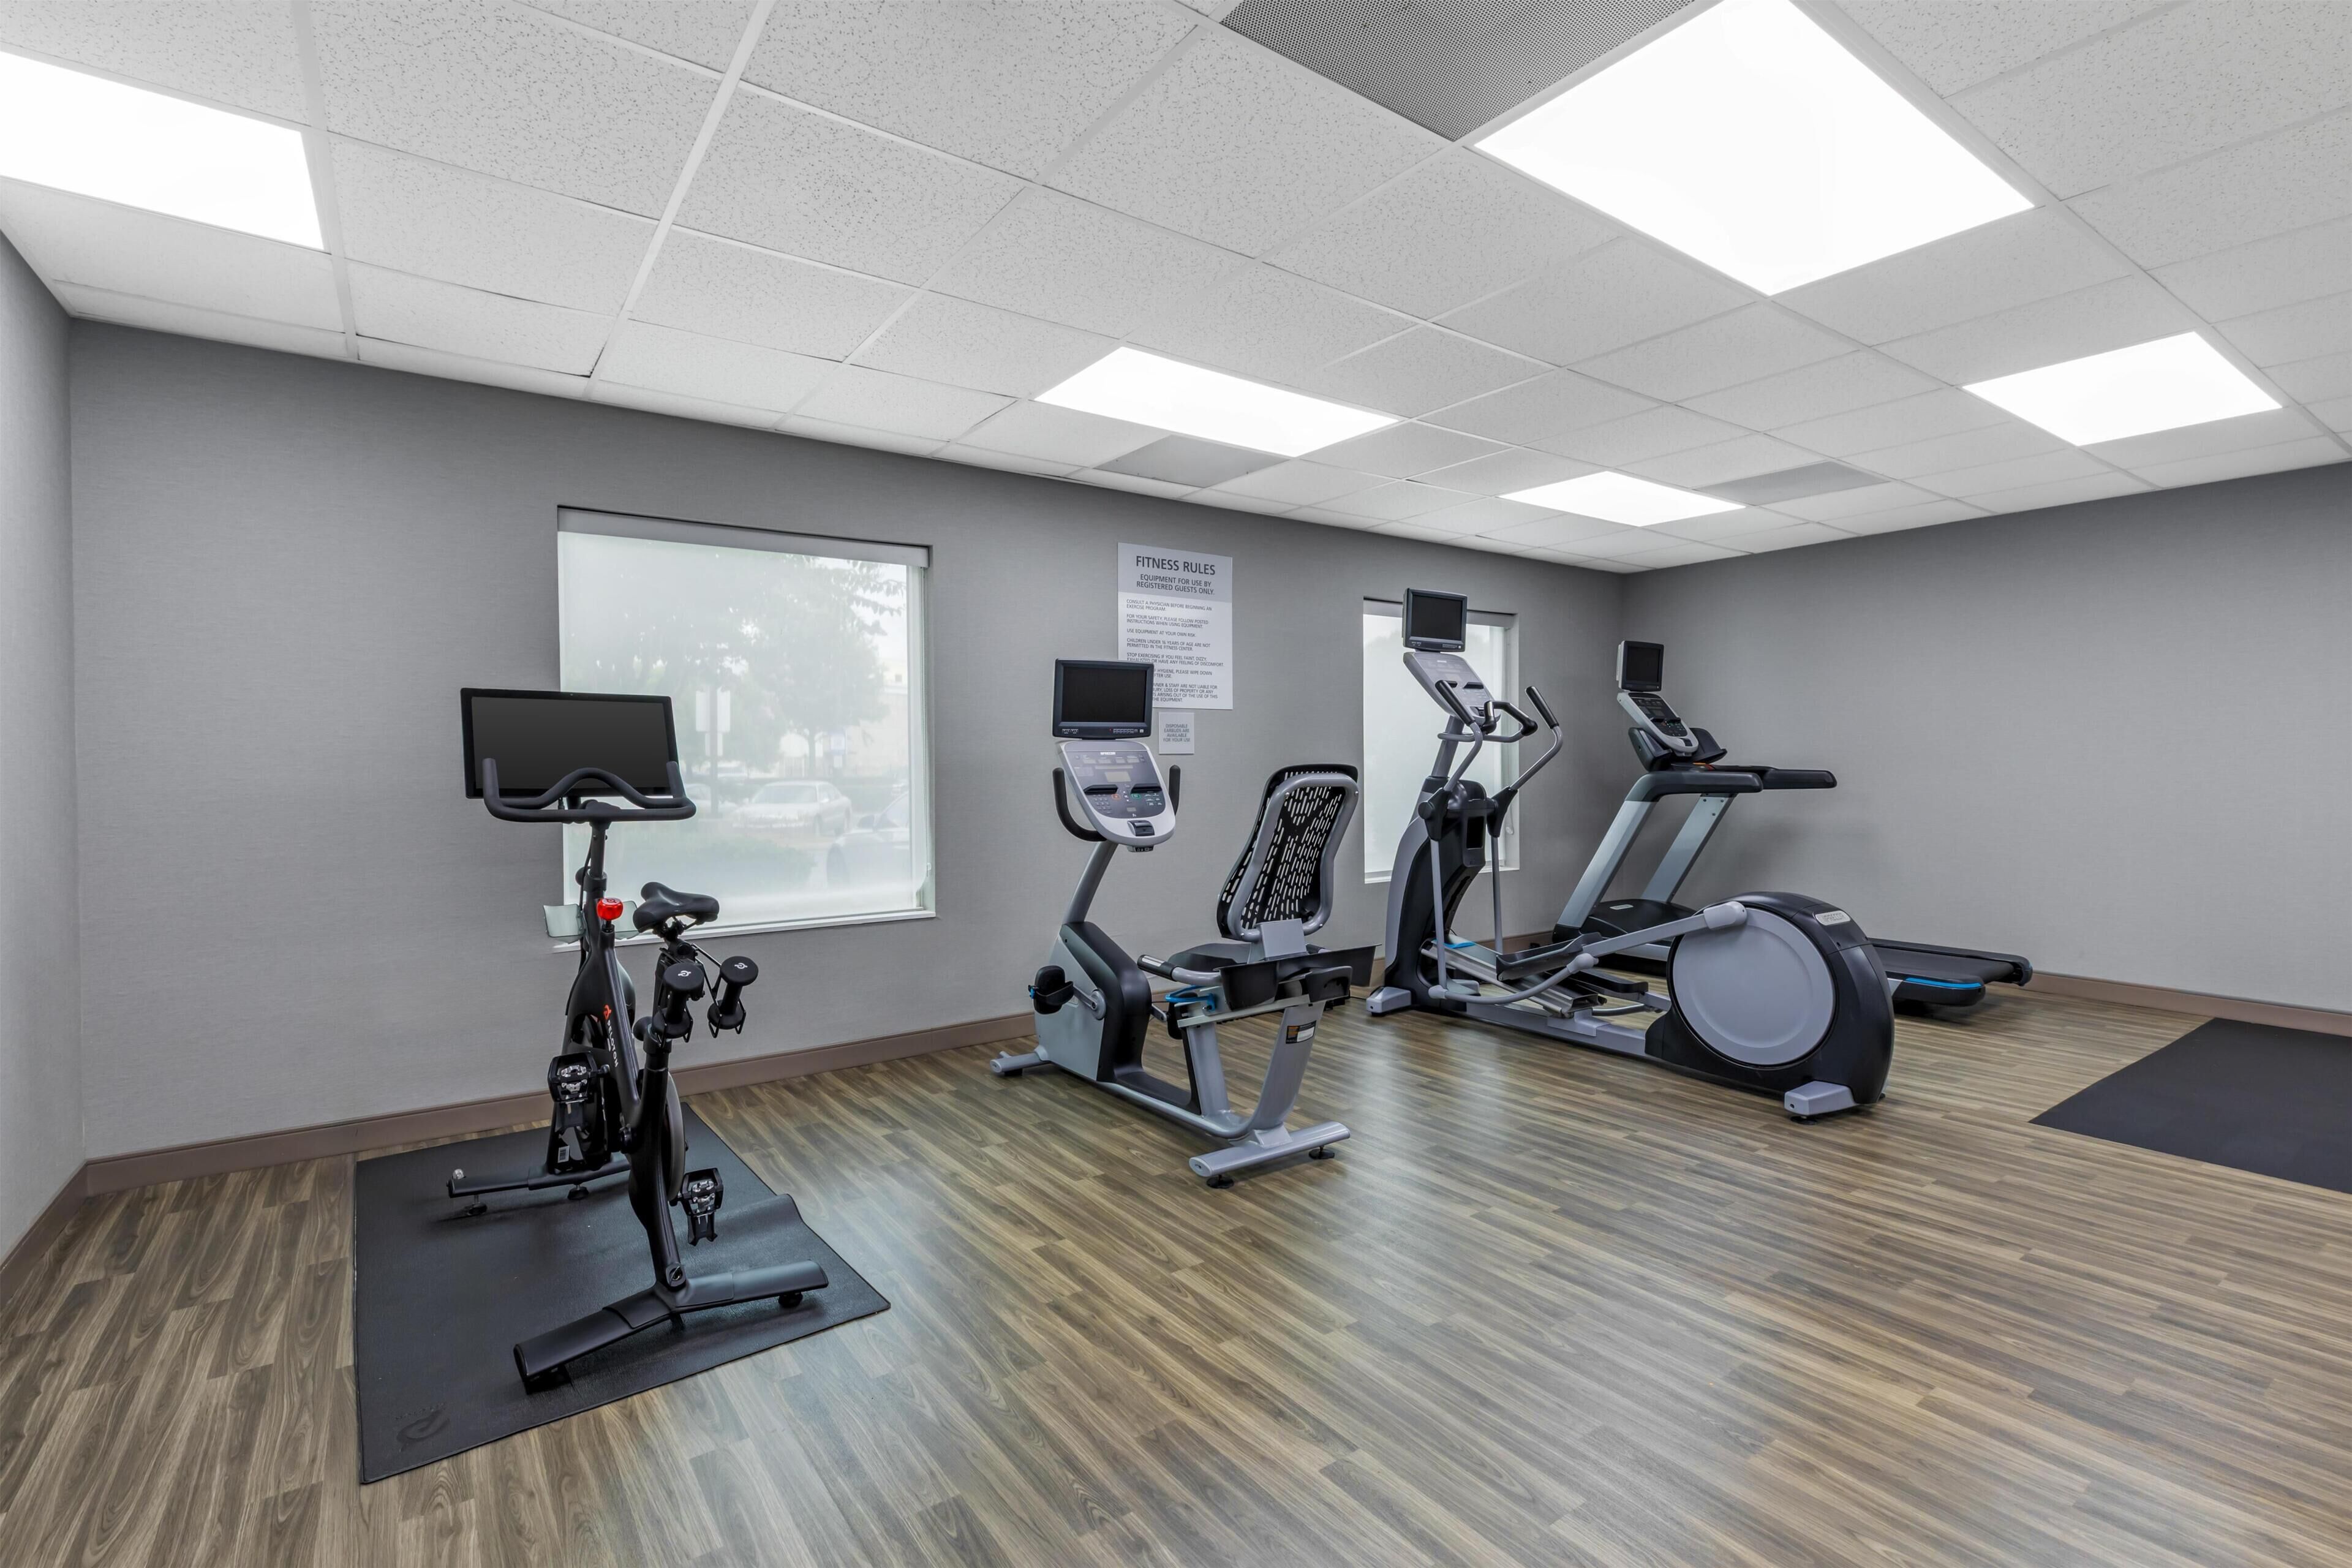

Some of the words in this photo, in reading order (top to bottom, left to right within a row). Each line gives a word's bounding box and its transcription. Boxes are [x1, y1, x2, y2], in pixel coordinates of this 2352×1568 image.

[1136, 556, 1179, 571] FITNESS
[1183, 562, 1215, 575] RULES
[1137, 581, 1172, 590] REGISTERED
[1140, 574, 1176, 583] EQUIPMENT
[607, 1020, 619, 1068] PELOTON
